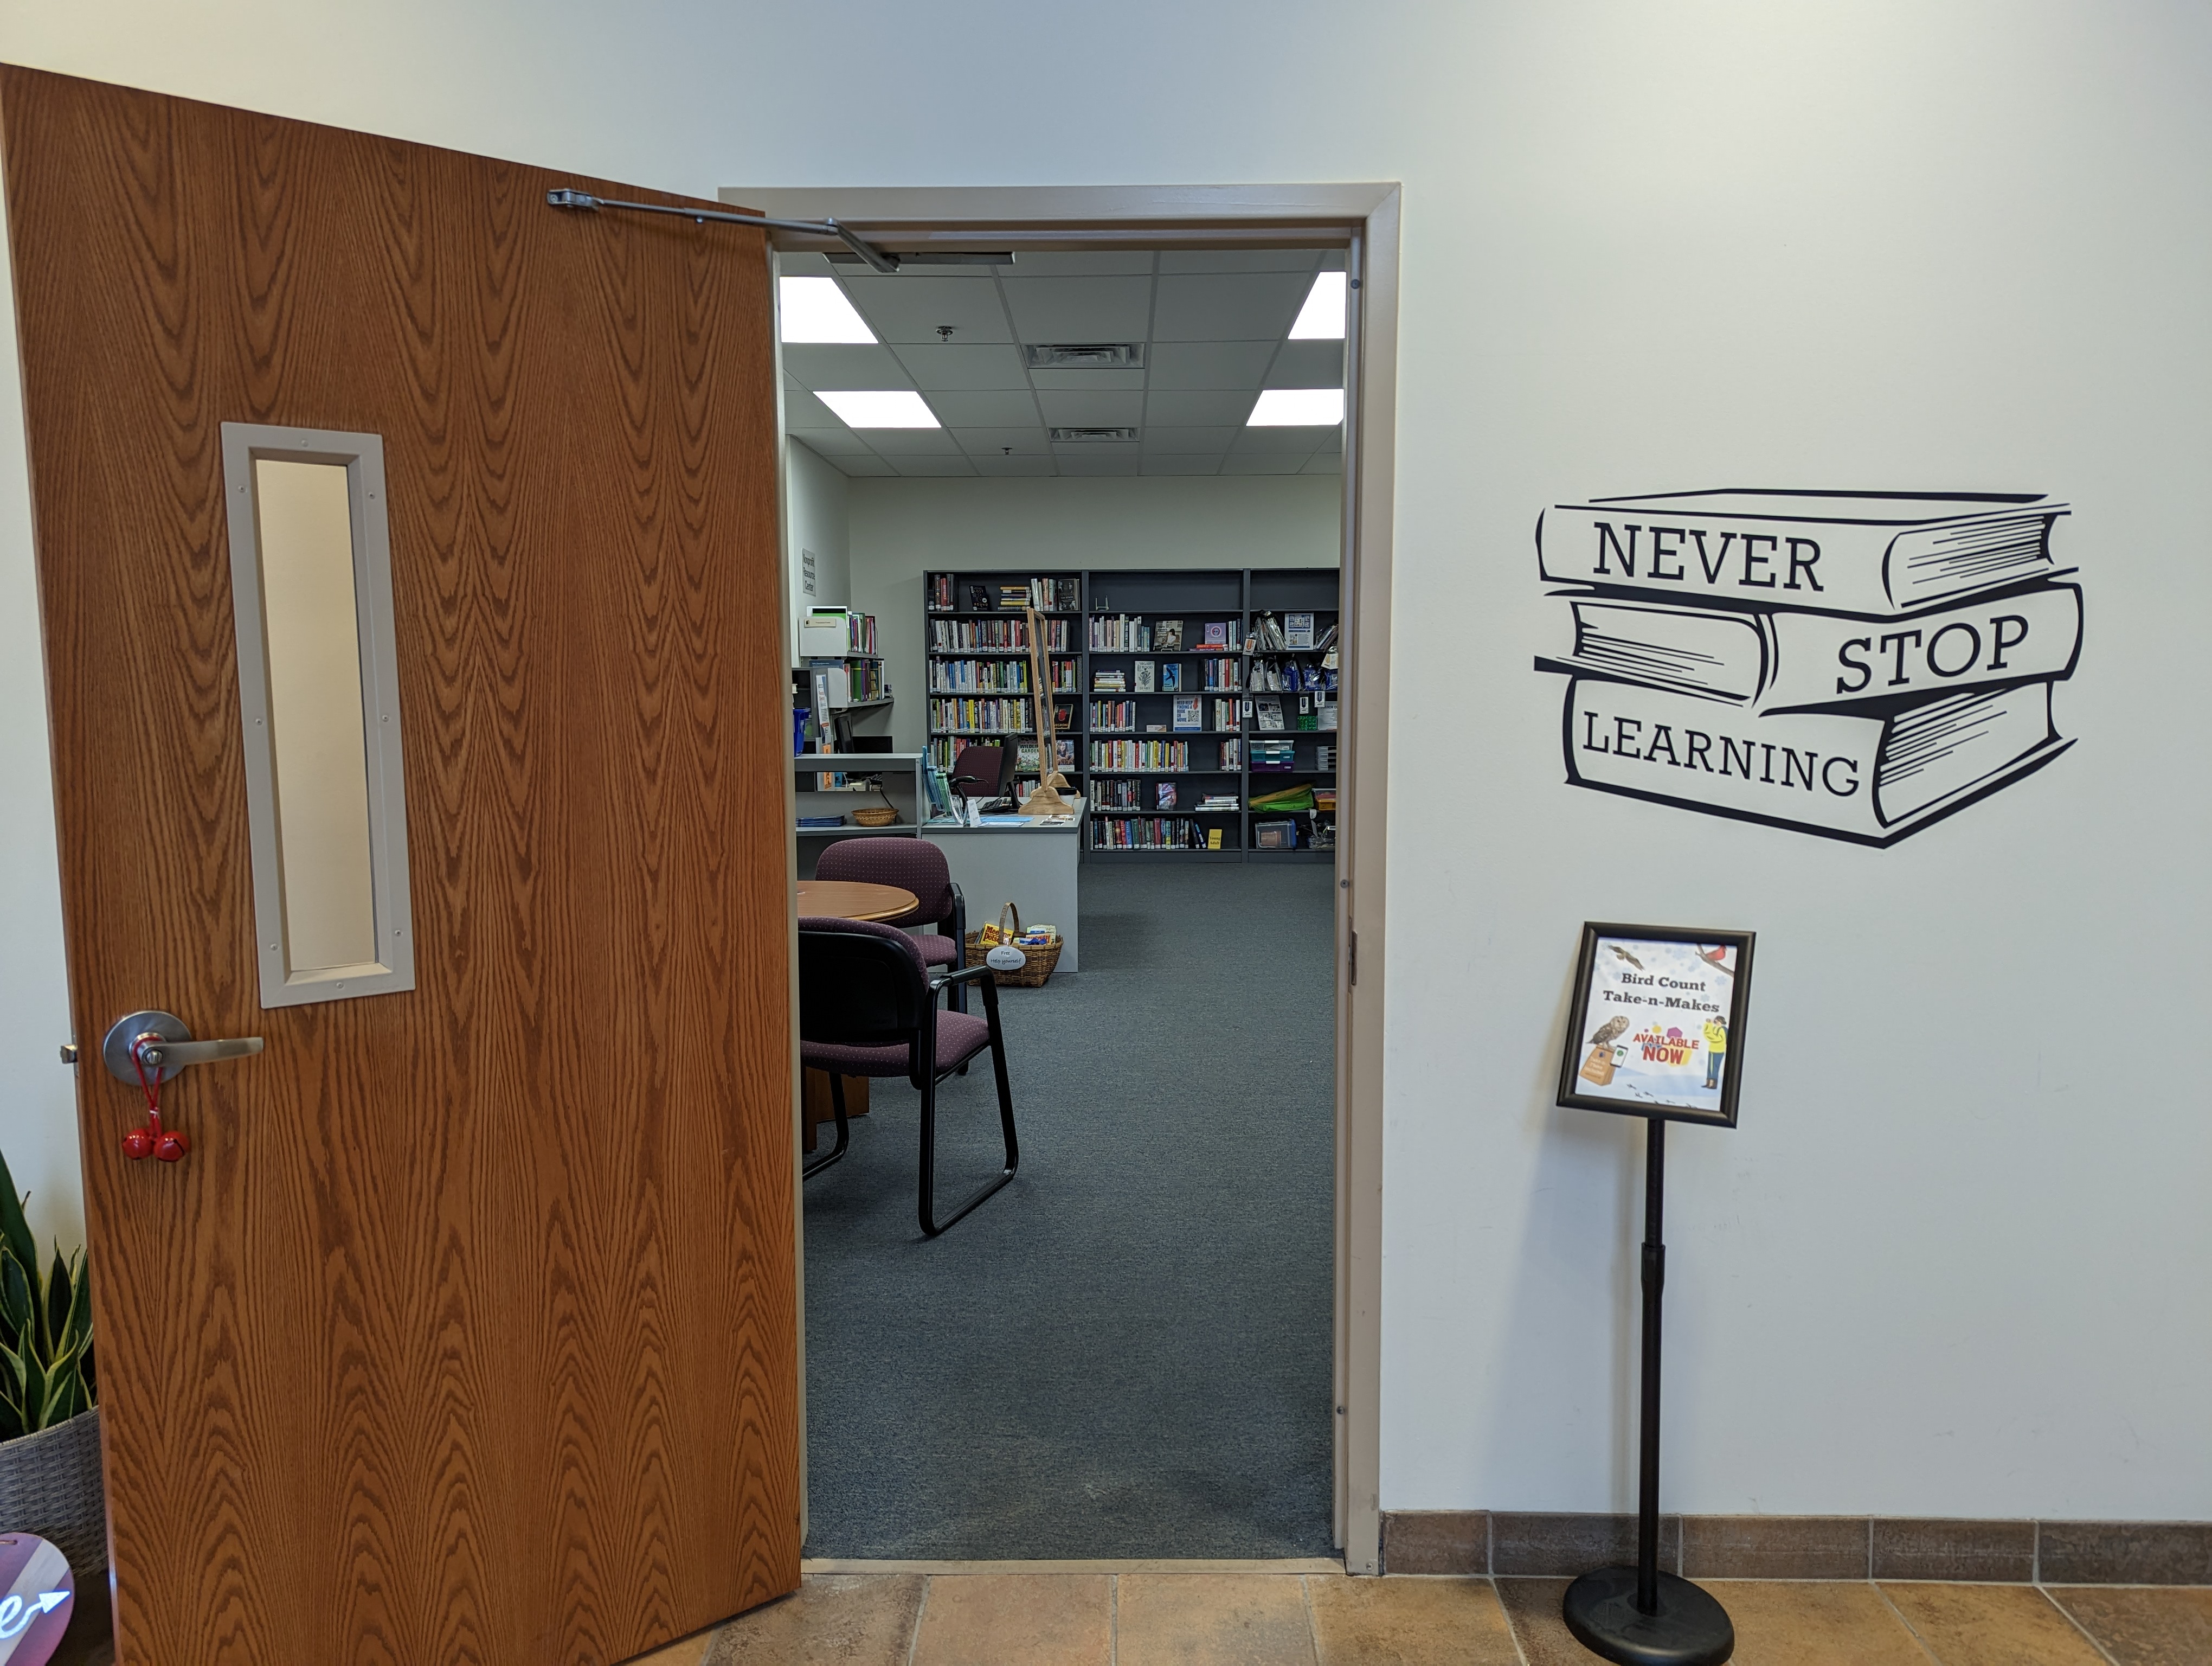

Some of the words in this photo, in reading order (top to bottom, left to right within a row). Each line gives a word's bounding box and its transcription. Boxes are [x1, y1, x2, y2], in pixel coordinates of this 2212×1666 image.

[1592, 521, 1824, 592] NEVER
[1836, 614, 2029, 694] STOP
[1583, 710, 1860, 797] LEARNING
[1621, 973, 1654, 986] Bird
[1658, 977, 1706, 992] Count
[1603, 990, 1720, 1013] Take-n-Makes
[1632, 1033, 1700, 1049] AVAILABLE
[1643, 1046, 1684, 1065] NOW
